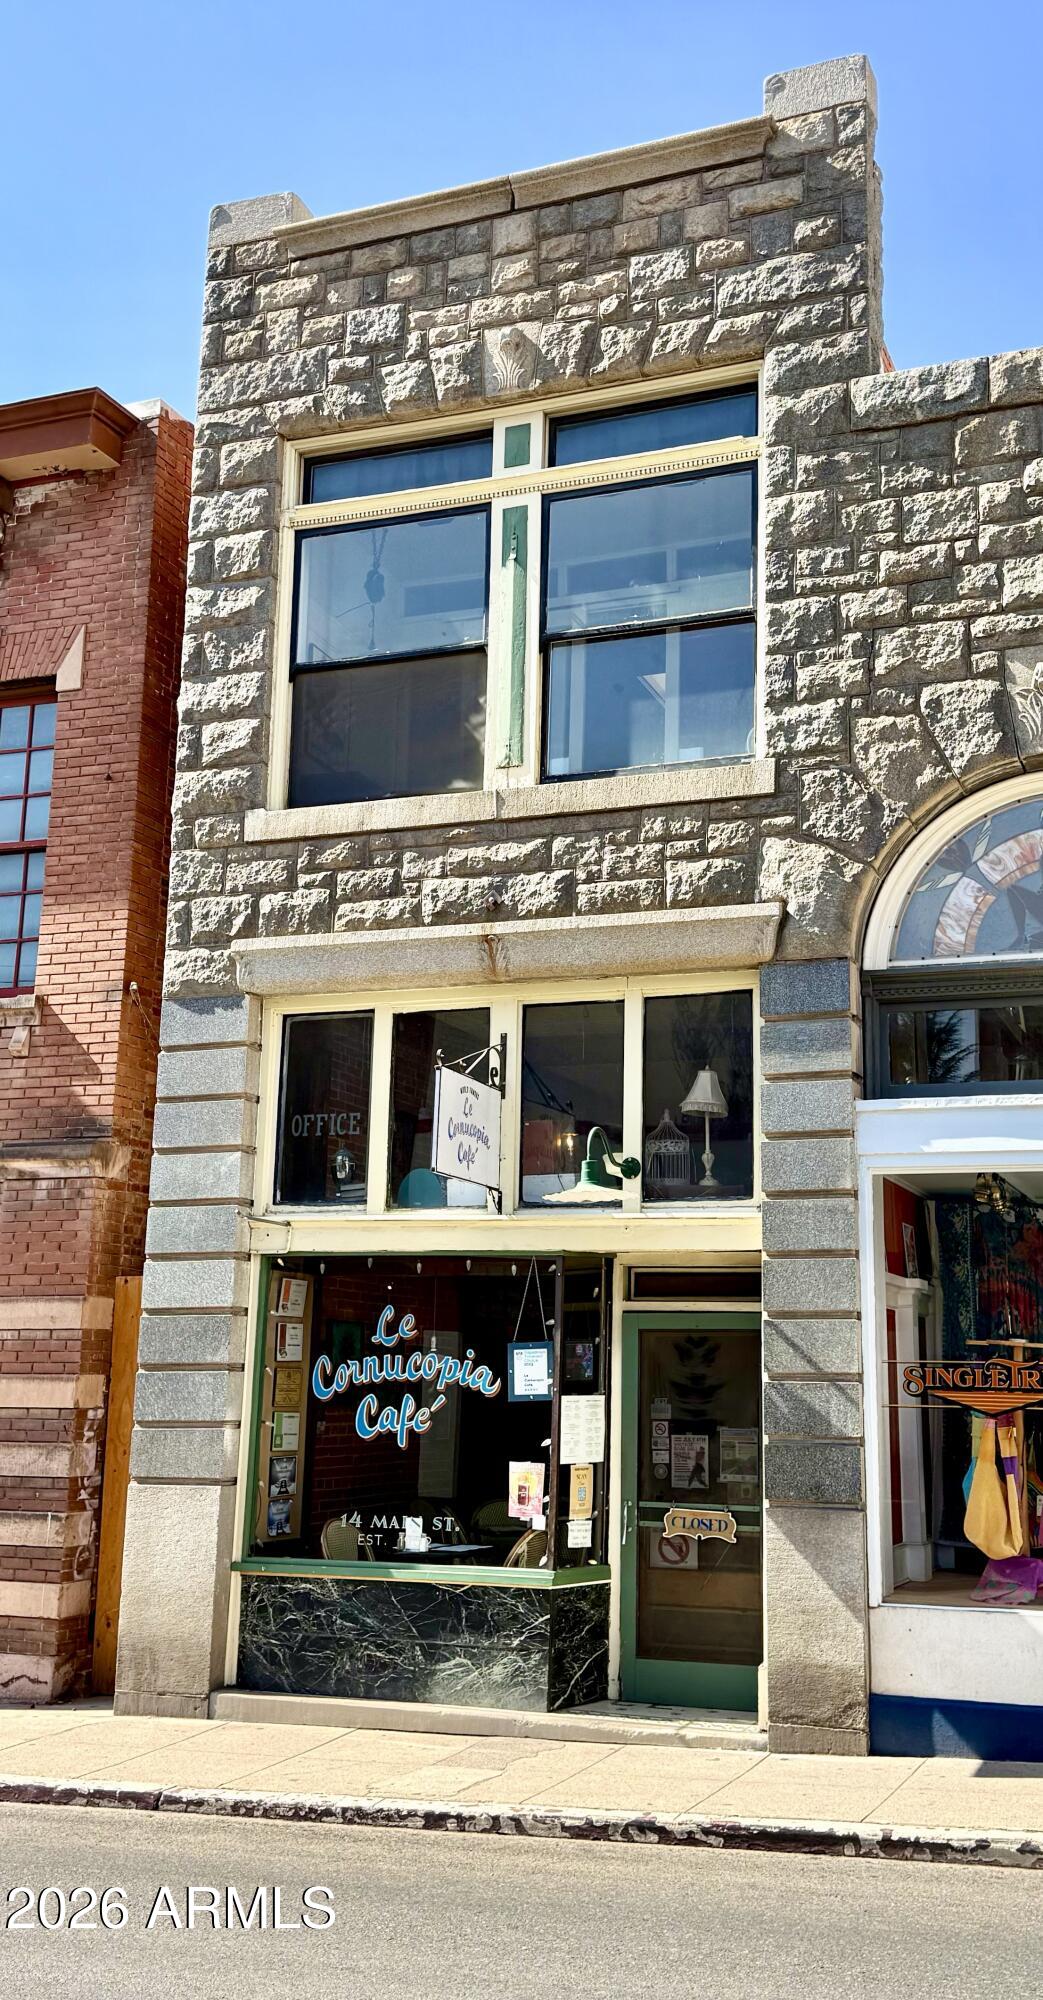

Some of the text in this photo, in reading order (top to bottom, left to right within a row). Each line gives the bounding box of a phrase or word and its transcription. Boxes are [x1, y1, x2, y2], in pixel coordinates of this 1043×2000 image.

[463, 1097, 473, 1118] Le
[291, 1113, 361, 1137] OFFICE
[447, 1117, 491, 1150] Cornucopia
[457, 1141, 478, 1171] Café
[372, 1304, 418, 1348] Le
[312, 1348, 501, 1402] Cornucopia
[903, 1358, 1043, 1397] SINGLETR
[355, 1392, 447, 1449] Café
[340, 1510, 363, 1528] 14
[432, 1516, 460, 1532] ST.
[671, 1516, 728, 1533] CLOSED
[357, 1533, 387, 1546] EST.
